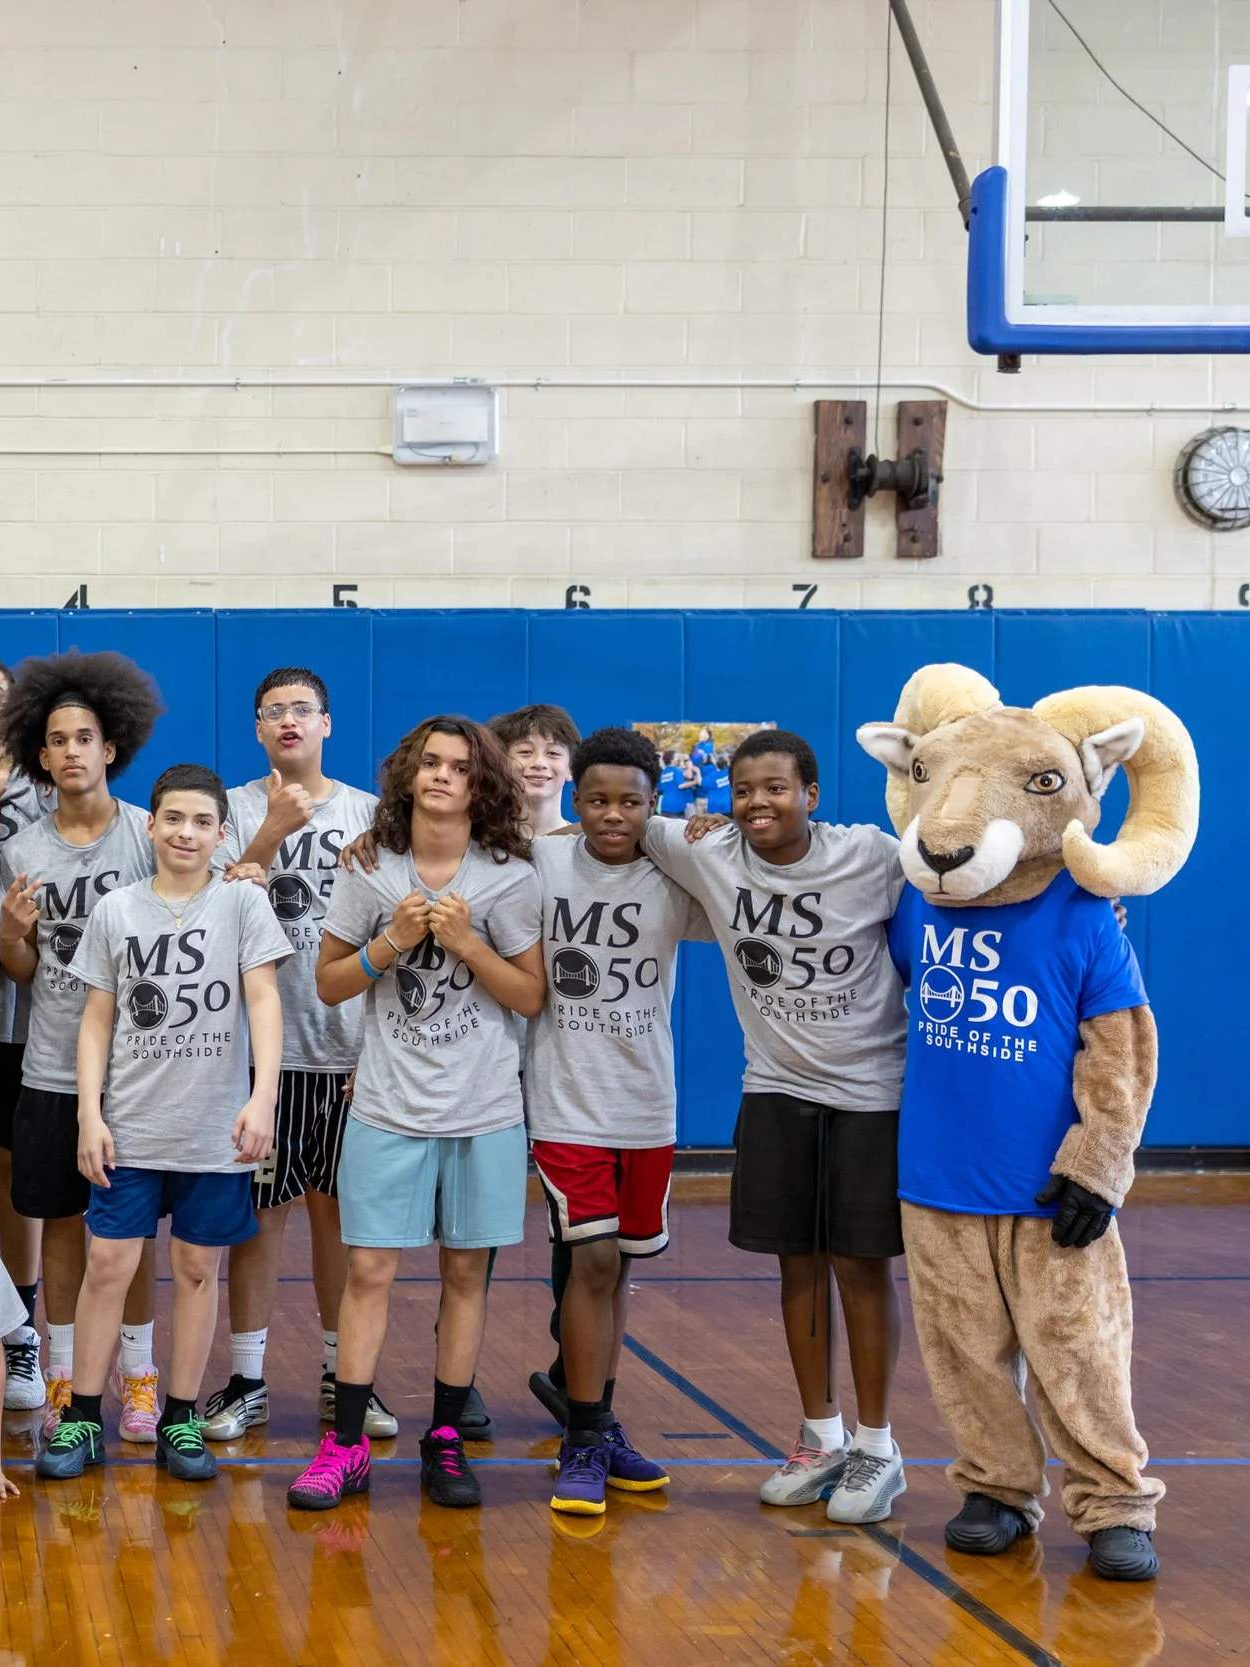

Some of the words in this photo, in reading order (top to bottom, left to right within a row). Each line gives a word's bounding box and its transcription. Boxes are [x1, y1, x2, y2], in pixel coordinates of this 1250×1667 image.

[792, 584, 818, 608] 7
[271, 829, 345, 871] MS
[549, 897, 642, 948] MS
[729, 886, 823, 938] MS
[125, 929, 206, 979] MS
[920, 924, 1002, 972] MS
[601, 957, 659, 1003] 50
[785, 945, 854, 990] 50
[168, 980, 230, 1029] 50
[422, 959, 475, 1021] 50
[794, 997, 818, 1008] OF
[826, 991, 857, 1005] THE
[968, 978, 1038, 1028] 50
[430, 1018, 451, 1033] OF
[457, 1002, 481, 1022] THE
[558, 1019, 653, 1038] SOUTHSIDE
[610, 1011, 631, 1023] OF
[636, 1006, 657, 1021] THE
[760, 1006, 851, 1022] OUTHSIDE
[127, 1036, 167, 1046] PRIDE
[175, 1034, 196, 1044] OF
[202, 1032, 231, 1042] THE
[133, 1046, 223, 1060] SOUTHSIDE
[918, 1021, 958, 1038] PRIDE
[969, 1030, 991, 1043] OF
[1002, 1035, 1037, 1052] THE
[926, 1034, 1024, 1062] SOUTHSIDE
